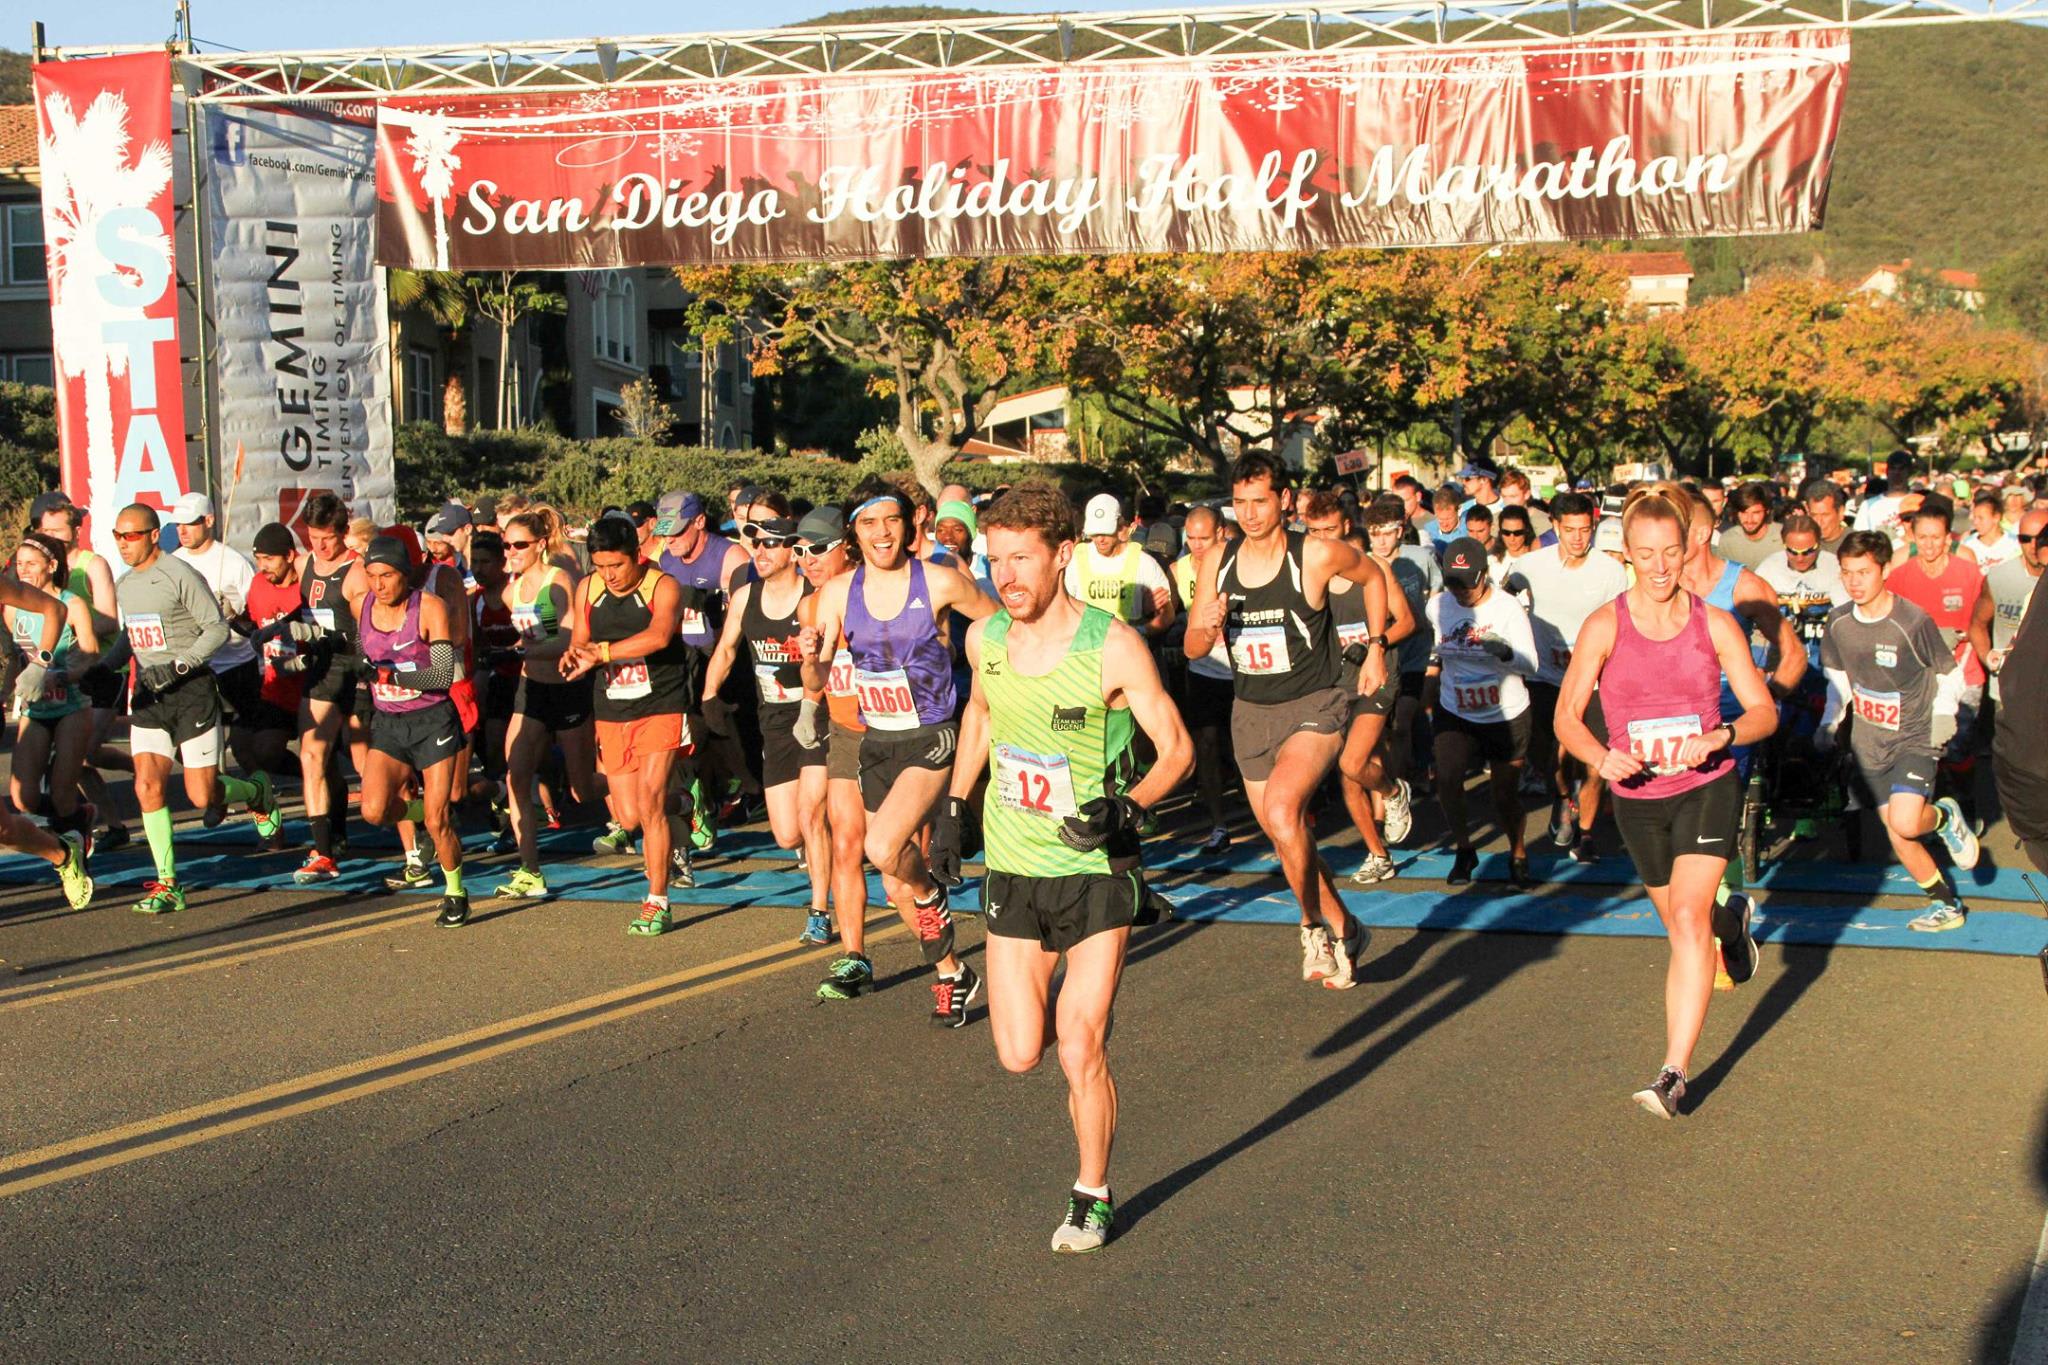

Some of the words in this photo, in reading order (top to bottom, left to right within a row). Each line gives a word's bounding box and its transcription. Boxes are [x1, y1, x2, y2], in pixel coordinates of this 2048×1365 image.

[462, 179, 590, 235] San
[611, 172, 786, 245] Diego
[806, 158, 1104, 234] Holiday
[1126, 147, 1319, 230] Half
[1343, 134, 1736, 208] Marathon
[331, 223, 345, 307] TIMING
[265, 221, 314, 472] GEMINI
[334, 318, 347, 348] OF
[312, 356, 332, 469] TIMING
[309, 579, 326, 608] P
[1088, 580, 1126, 600] GUIDE
[128, 626, 164, 649] 1363
[758, 652, 789, 663] VALLEY
[1246, 643, 1273, 669] 15
[858, 685, 914, 713] 1060
[1454, 685, 1500, 709] 1318
[1854, 695, 1899, 725] 1852
[1634, 733, 1699, 769] 147
[1018, 770, 1053, 812] 12
